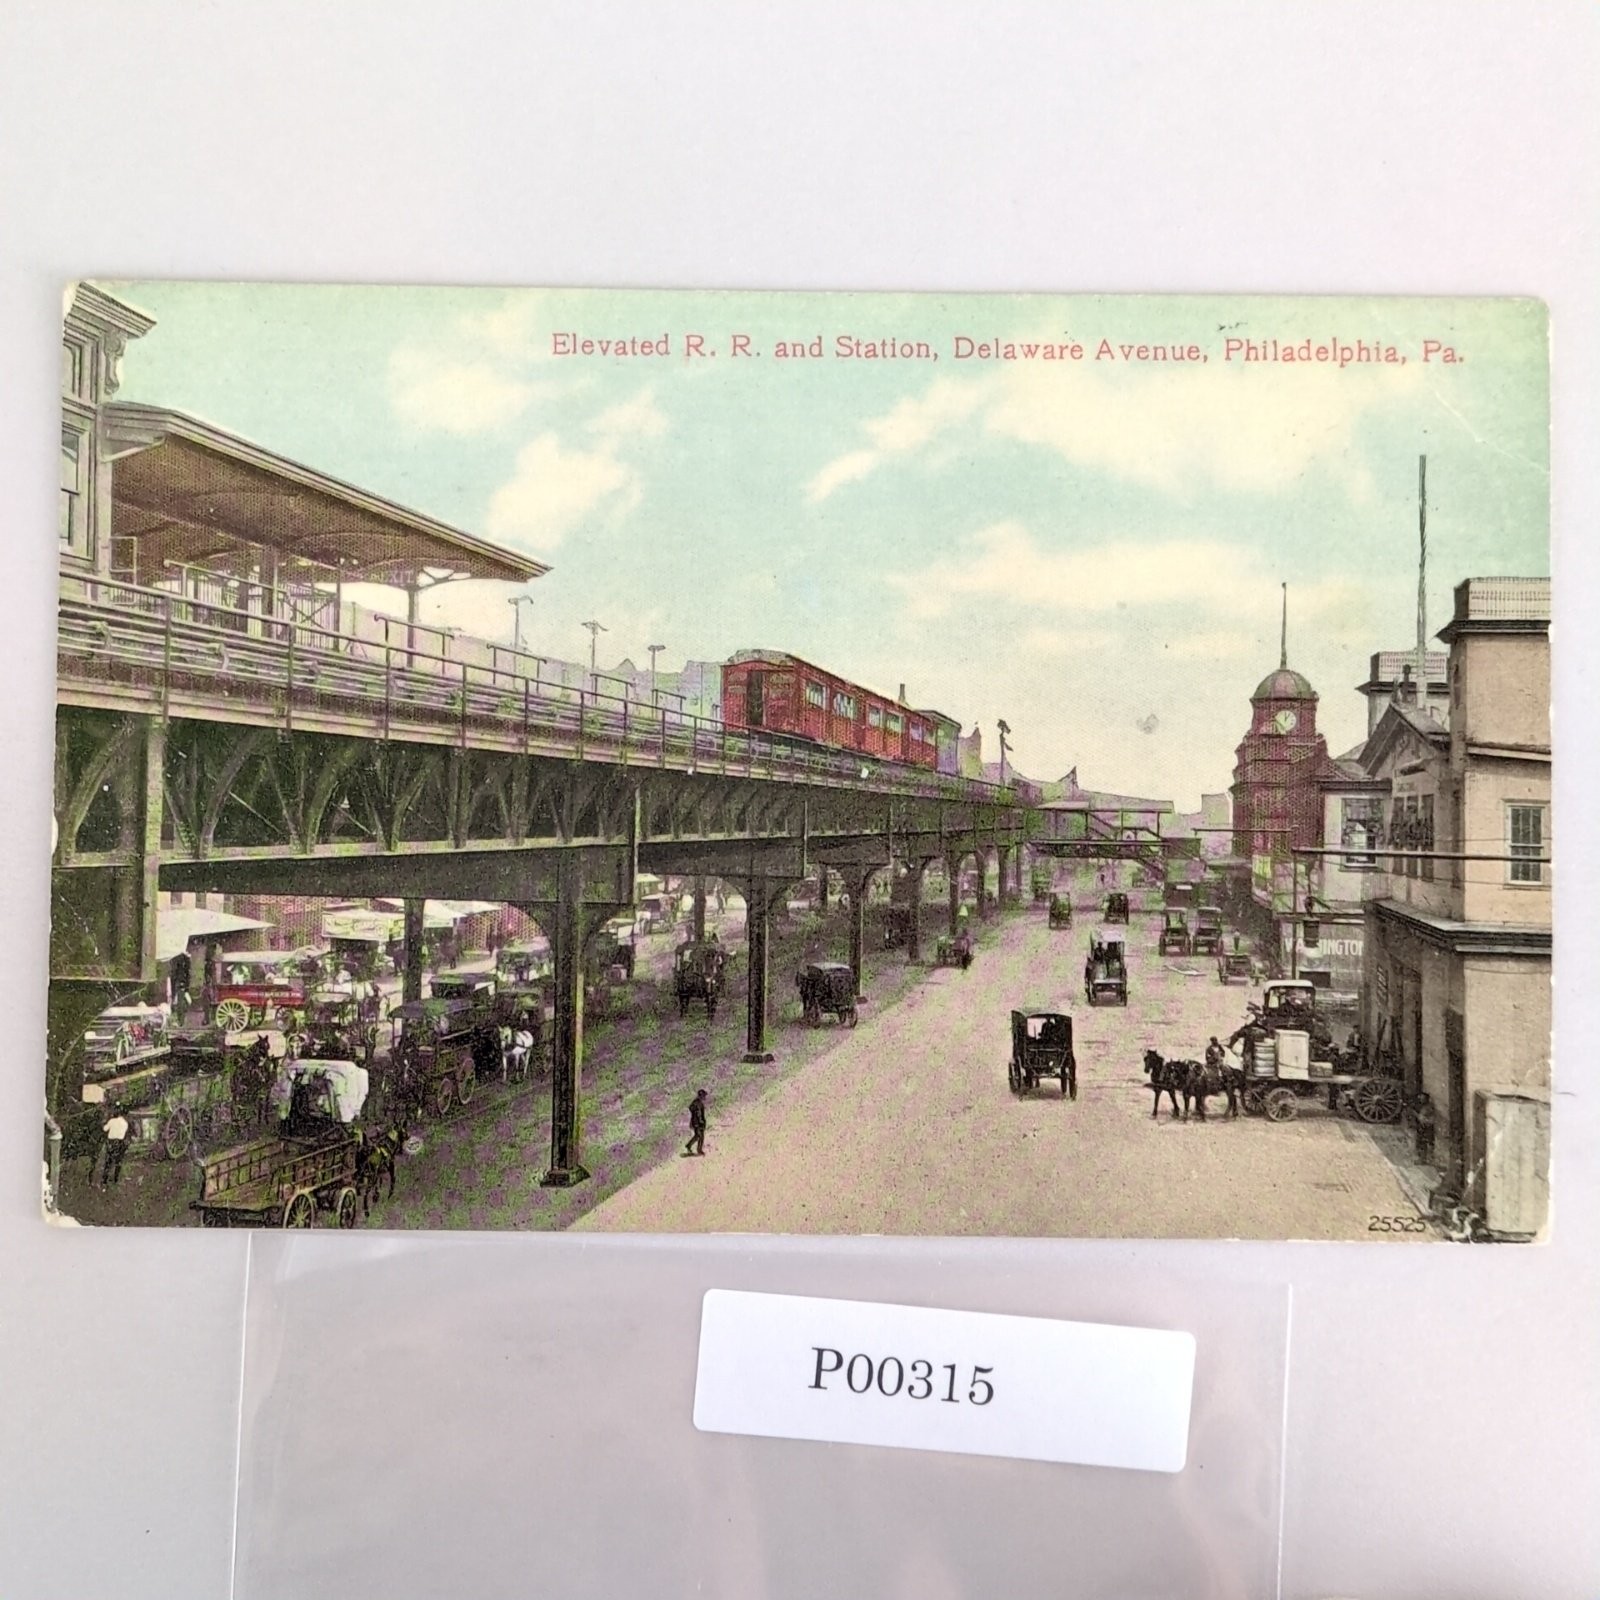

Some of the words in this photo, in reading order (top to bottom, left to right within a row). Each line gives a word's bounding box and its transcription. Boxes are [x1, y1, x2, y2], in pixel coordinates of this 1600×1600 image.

[551, 332, 671, 358] Elevated
[684, 334, 717, 359] R.
[731, 335, 762, 359] R.
[774, 336, 823, 359] and
[834, 336, 939, 362] Station,
[953, 336, 1084, 362] Delaware
[1094, 339, 1209, 364] Avenue,
[1223, 337, 1408, 369] Philadelphia,
[1421, 339, 1465, 364] Pa.
[1368, 1215, 1427, 1233] 25525
[808, 1347, 995, 1406] P00315
